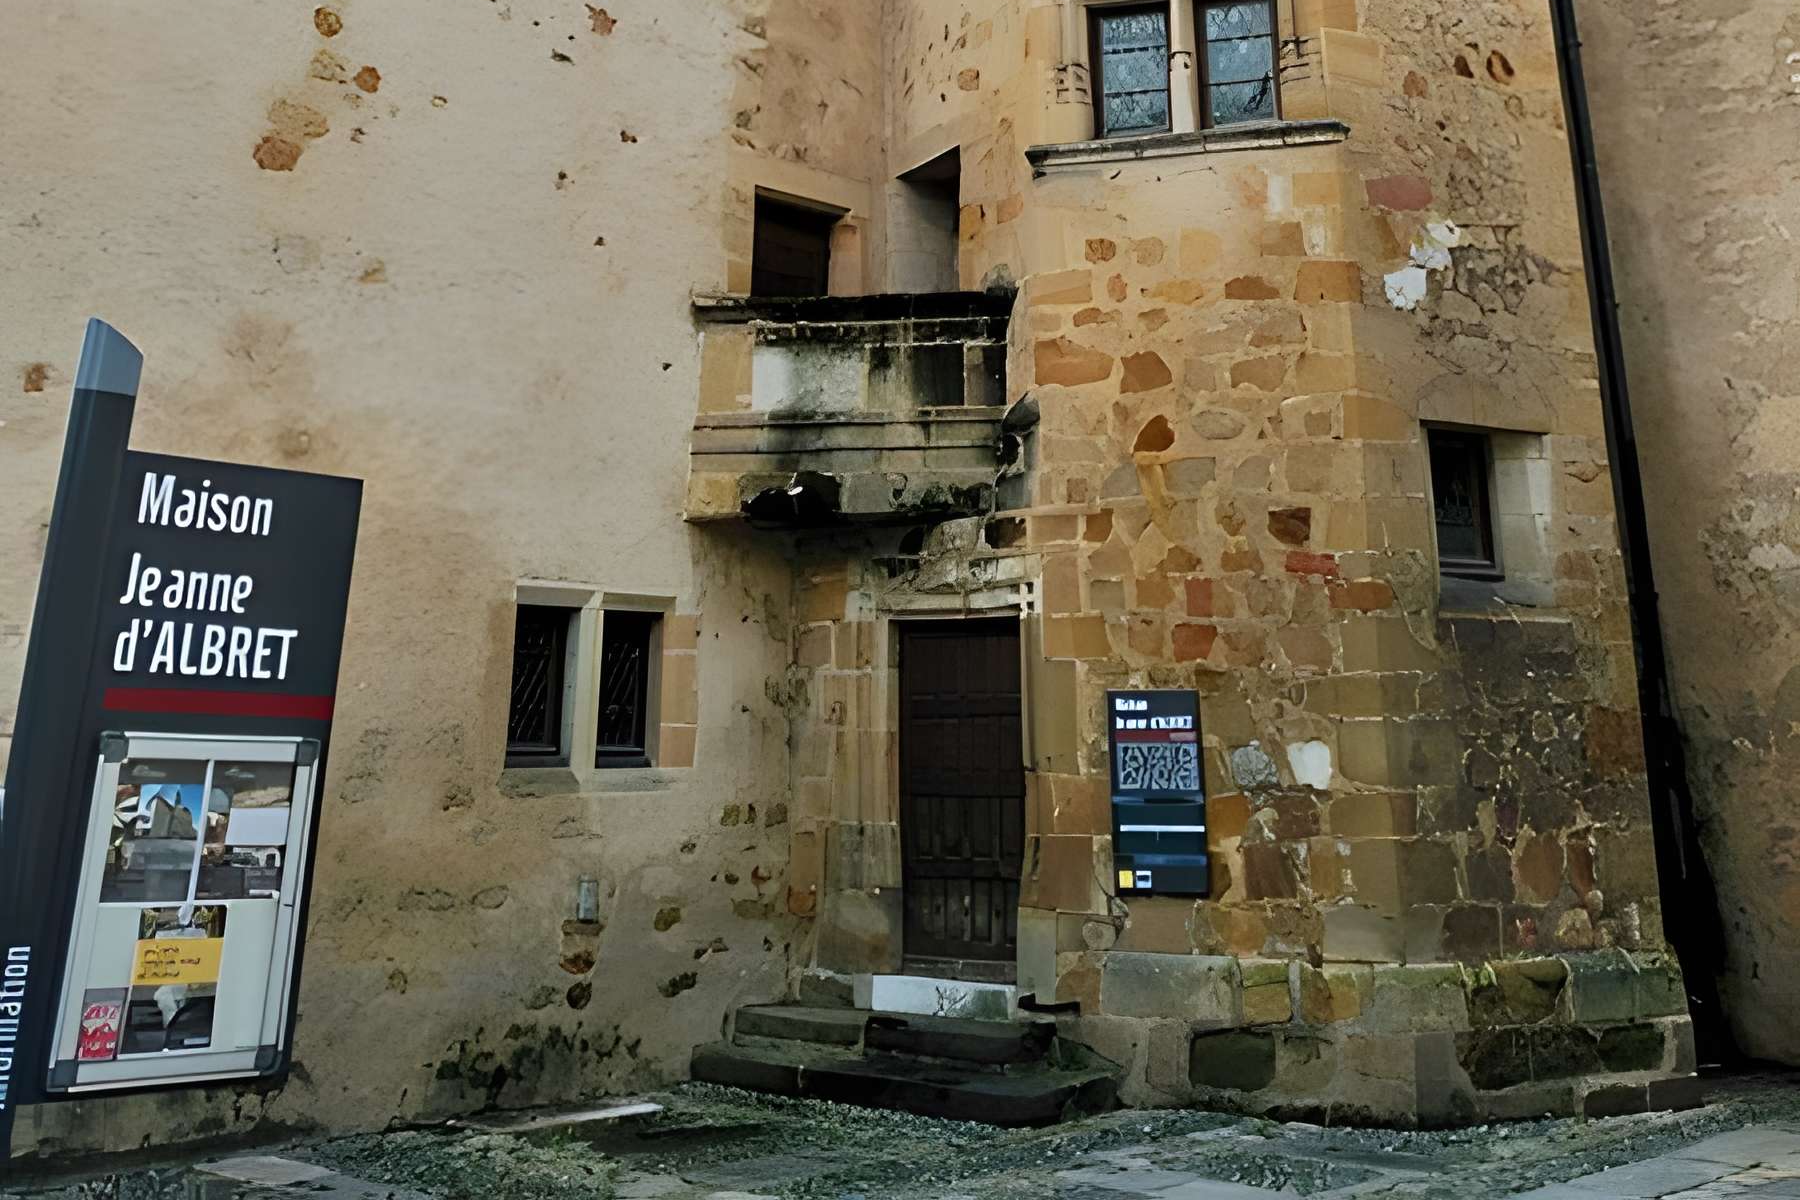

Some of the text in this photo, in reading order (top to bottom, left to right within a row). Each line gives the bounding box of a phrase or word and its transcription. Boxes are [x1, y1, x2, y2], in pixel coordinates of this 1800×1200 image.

[137, 471, 273, 536] Maison
[119, 552, 254, 614] Jeanne
[113, 618, 299, 680] d'ALBRET
